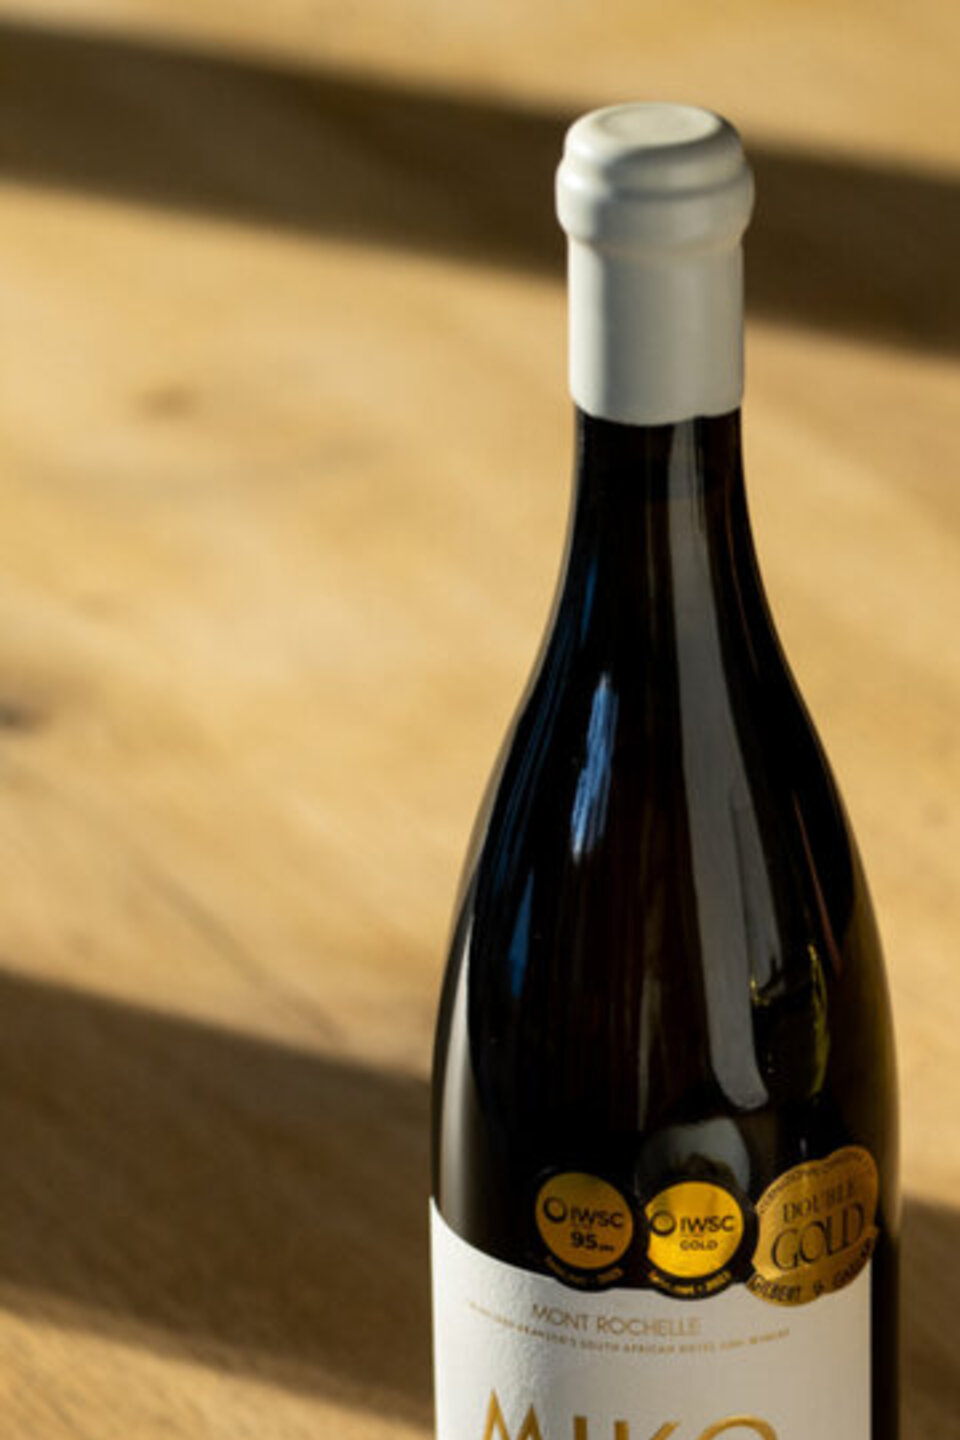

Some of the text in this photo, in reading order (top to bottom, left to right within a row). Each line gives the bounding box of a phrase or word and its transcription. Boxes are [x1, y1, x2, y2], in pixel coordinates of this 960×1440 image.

[570, 1205, 625, 1230] IWSC
[679, 1215, 735, 1234] IWSC
[570, 1231, 599, 1250] 95
[679, 1239, 719, 1252] GOLD
[770, 1203, 865, 1271] GOLD
[532, 1302, 590, 1332] MONT
[597, 1315, 701, 1338] ROCHELLE
